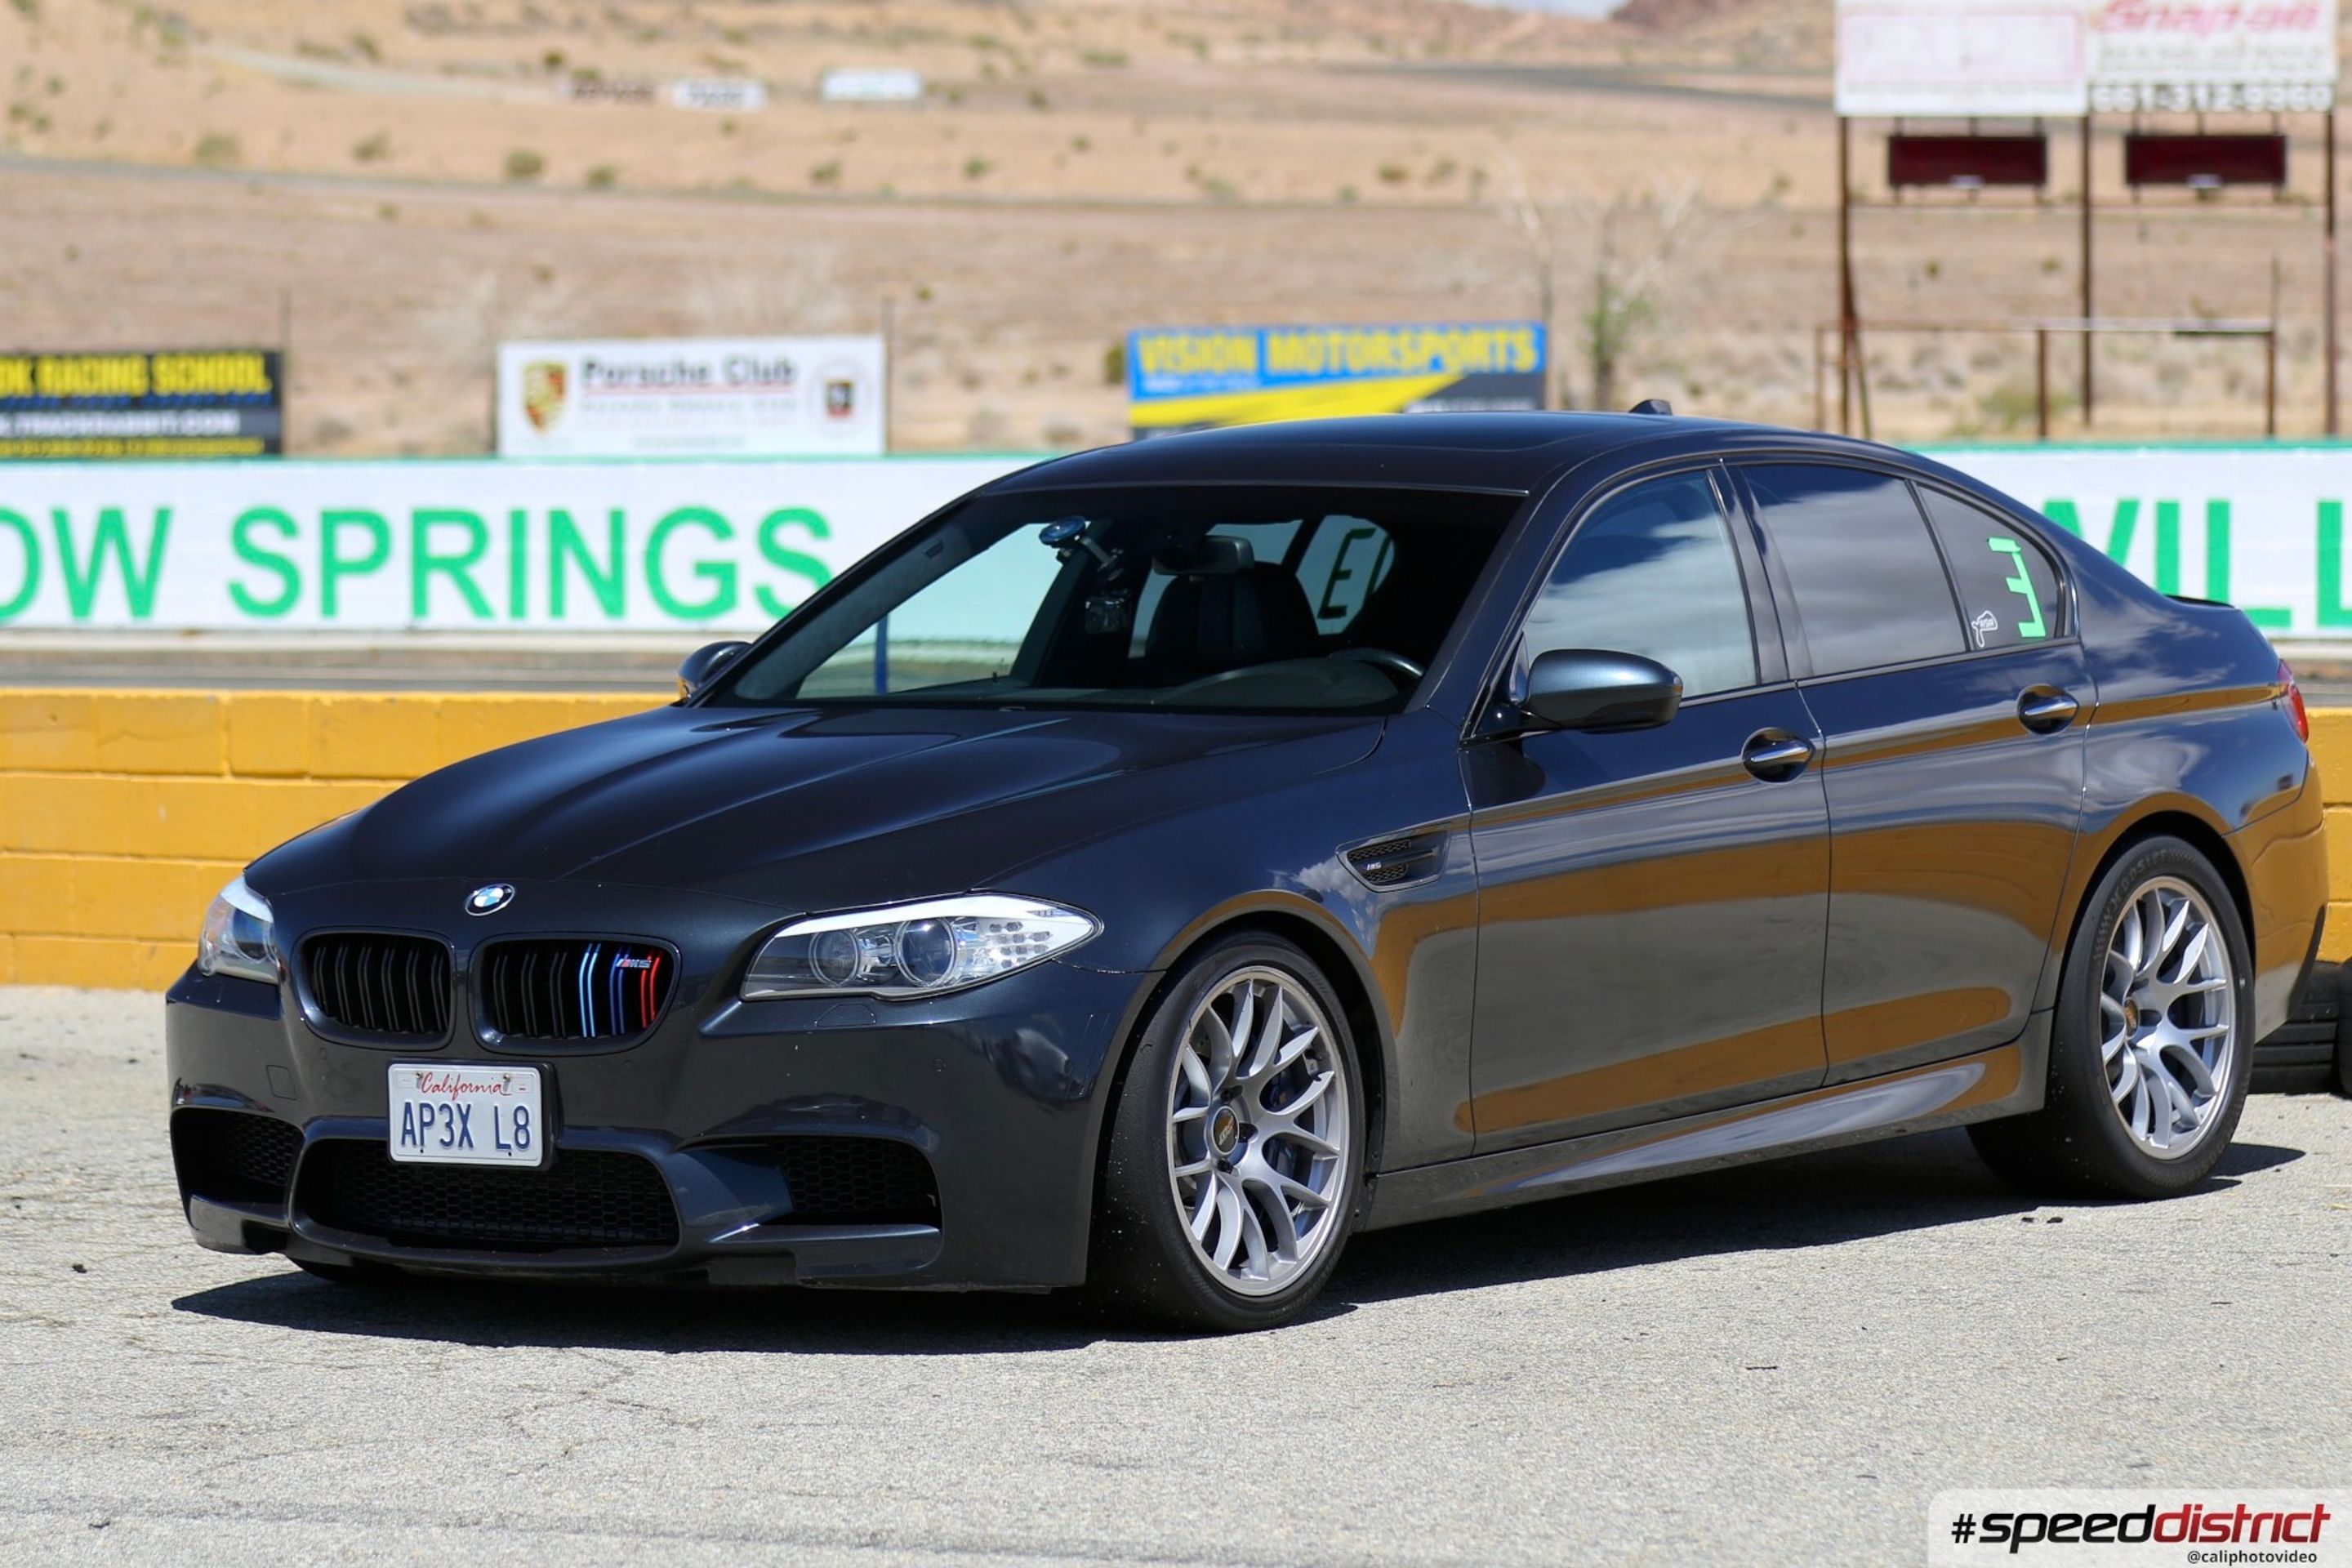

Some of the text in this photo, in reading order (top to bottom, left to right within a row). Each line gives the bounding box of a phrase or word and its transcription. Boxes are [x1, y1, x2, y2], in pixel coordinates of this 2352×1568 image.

[36, 353, 149, 397] RACING
[152, 350, 272, 394] SCHOOL
[582, 354, 797, 387] Porsche Club
[1138, 328, 1535, 374] VISION MOTORSPORTS
[228, 505, 832, 626] SPRINGS
[421, 1071, 513, 1101] California
[401, 1101, 532, 1151] AP3X L8
